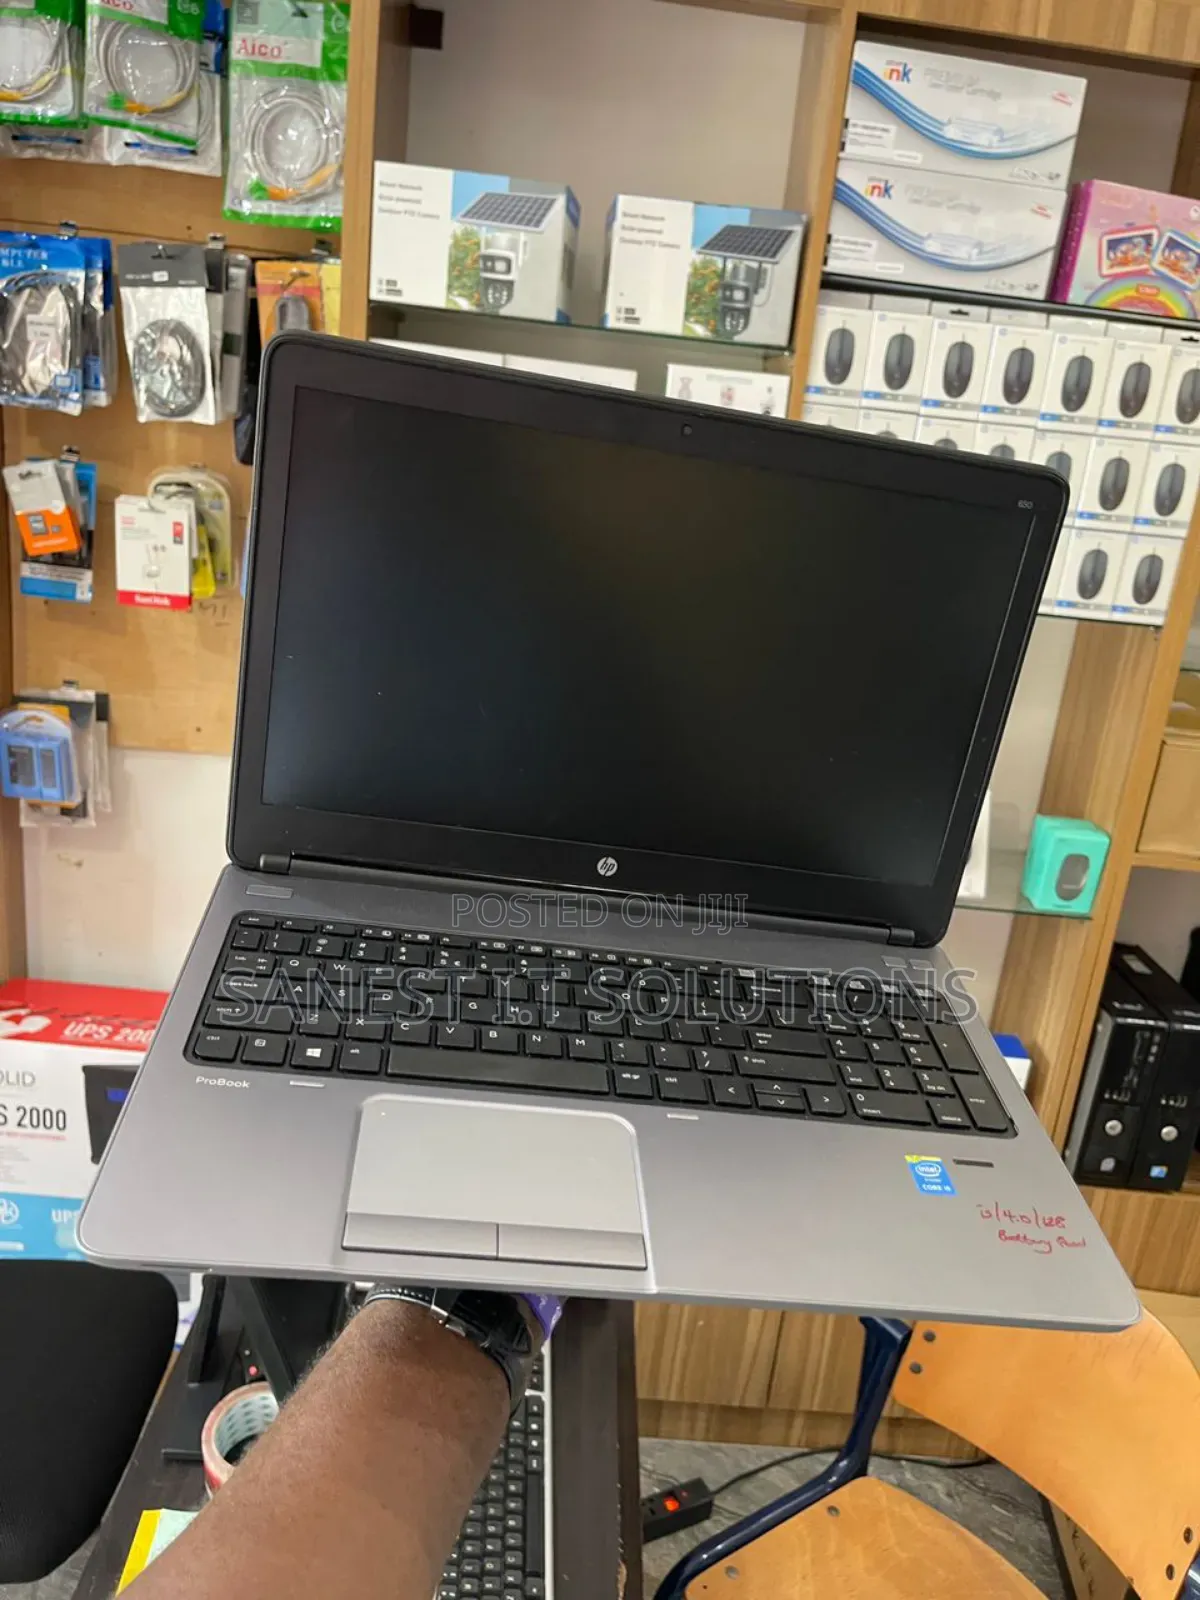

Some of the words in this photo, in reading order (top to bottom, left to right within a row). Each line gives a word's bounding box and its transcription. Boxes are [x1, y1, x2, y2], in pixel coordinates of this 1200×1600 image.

[236, 38, 282, 59] Aico
[598, 857, 617, 876] hp
[63, 1021, 113, 1040] UPS
[195, 1075, 250, 1088] ProBook
[856, 1093, 865, 1101] 0
[16, 1105, 67, 1131] 2000
